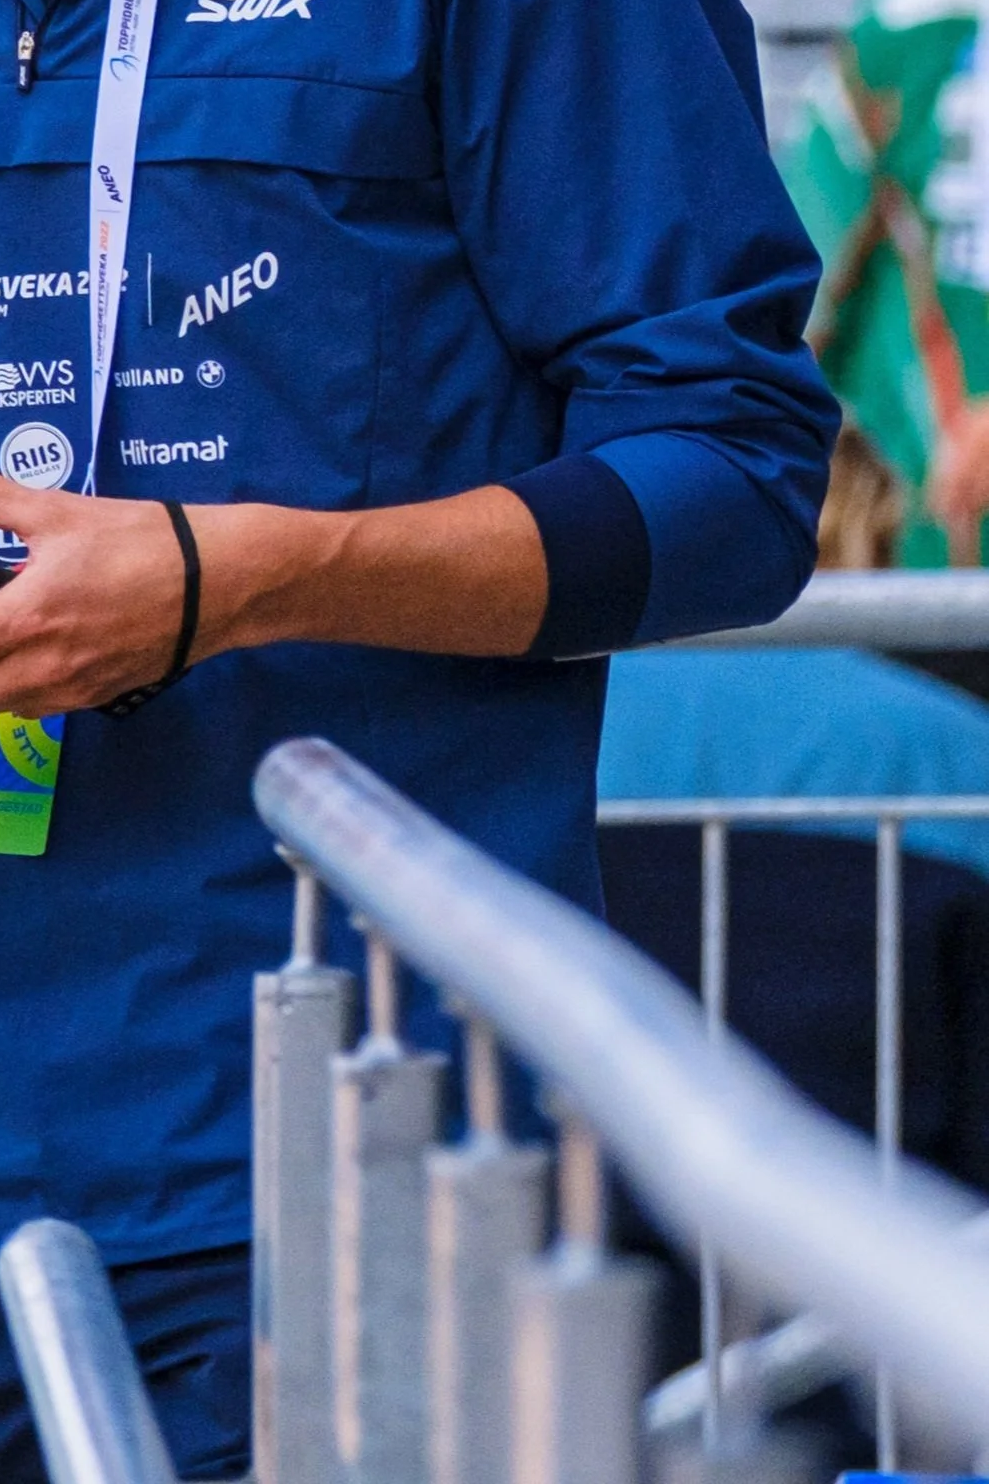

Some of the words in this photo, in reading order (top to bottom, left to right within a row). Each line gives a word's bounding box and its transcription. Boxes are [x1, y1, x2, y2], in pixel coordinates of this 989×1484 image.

[97, 165, 124, 203] ANEO
[99, 220, 110, 251] 2022
[178, 251, 279, 339] ANEO
[18, 359, 75, 388] VVS
[11, 442, 61, 472] RIIS
[120, 434, 229, 466] Hitramat
[12, 724, 51, 770] ALLE
